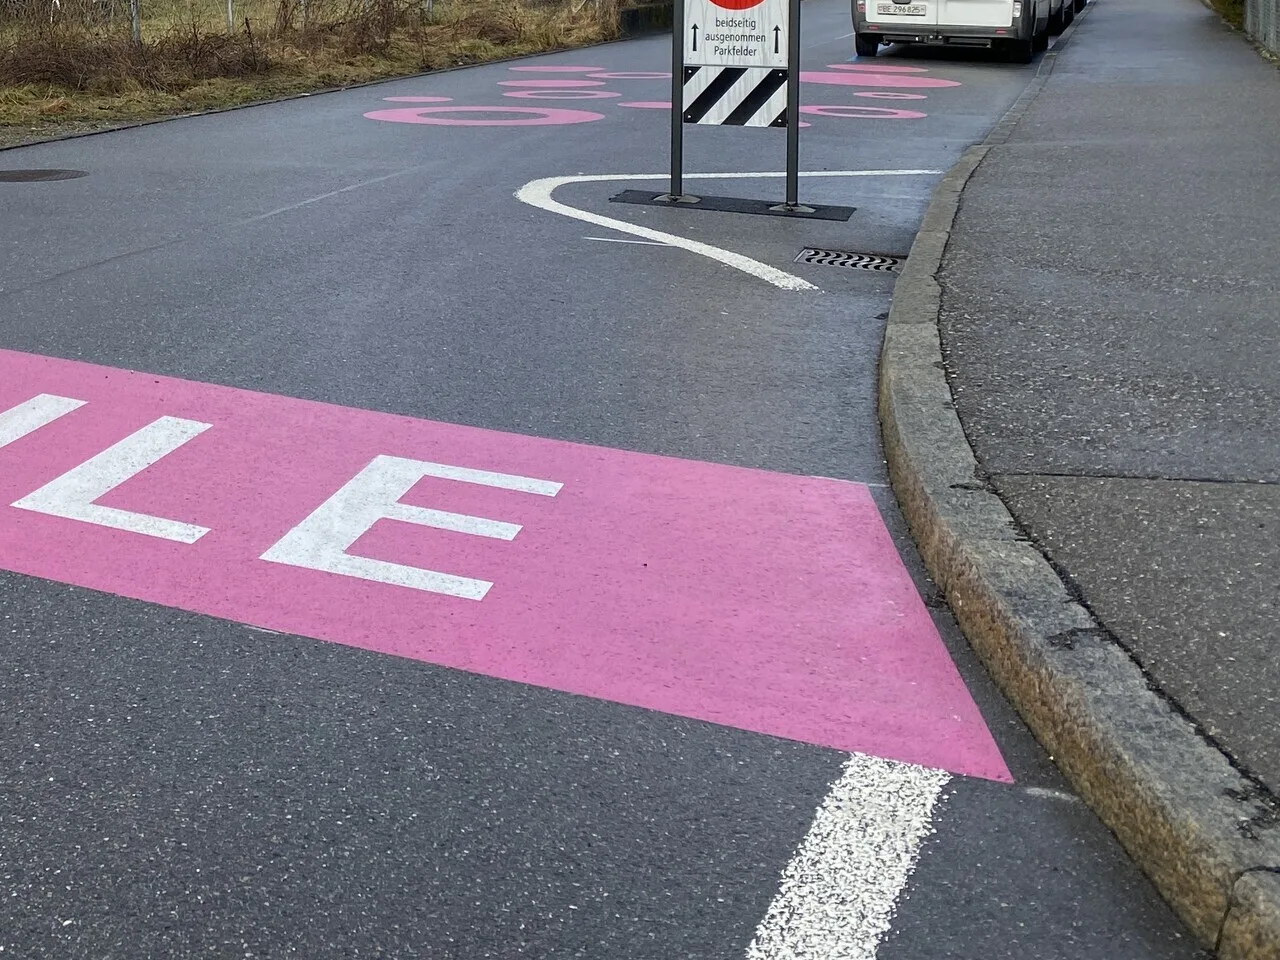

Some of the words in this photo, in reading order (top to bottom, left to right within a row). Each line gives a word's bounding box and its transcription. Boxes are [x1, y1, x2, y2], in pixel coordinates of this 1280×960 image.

[882, 5, 892, 13] BE
[715, 17, 756, 30] beidseitig
[705, 33, 766, 44] ausgenommen
[714, 46, 758, 57] Parkfelder
